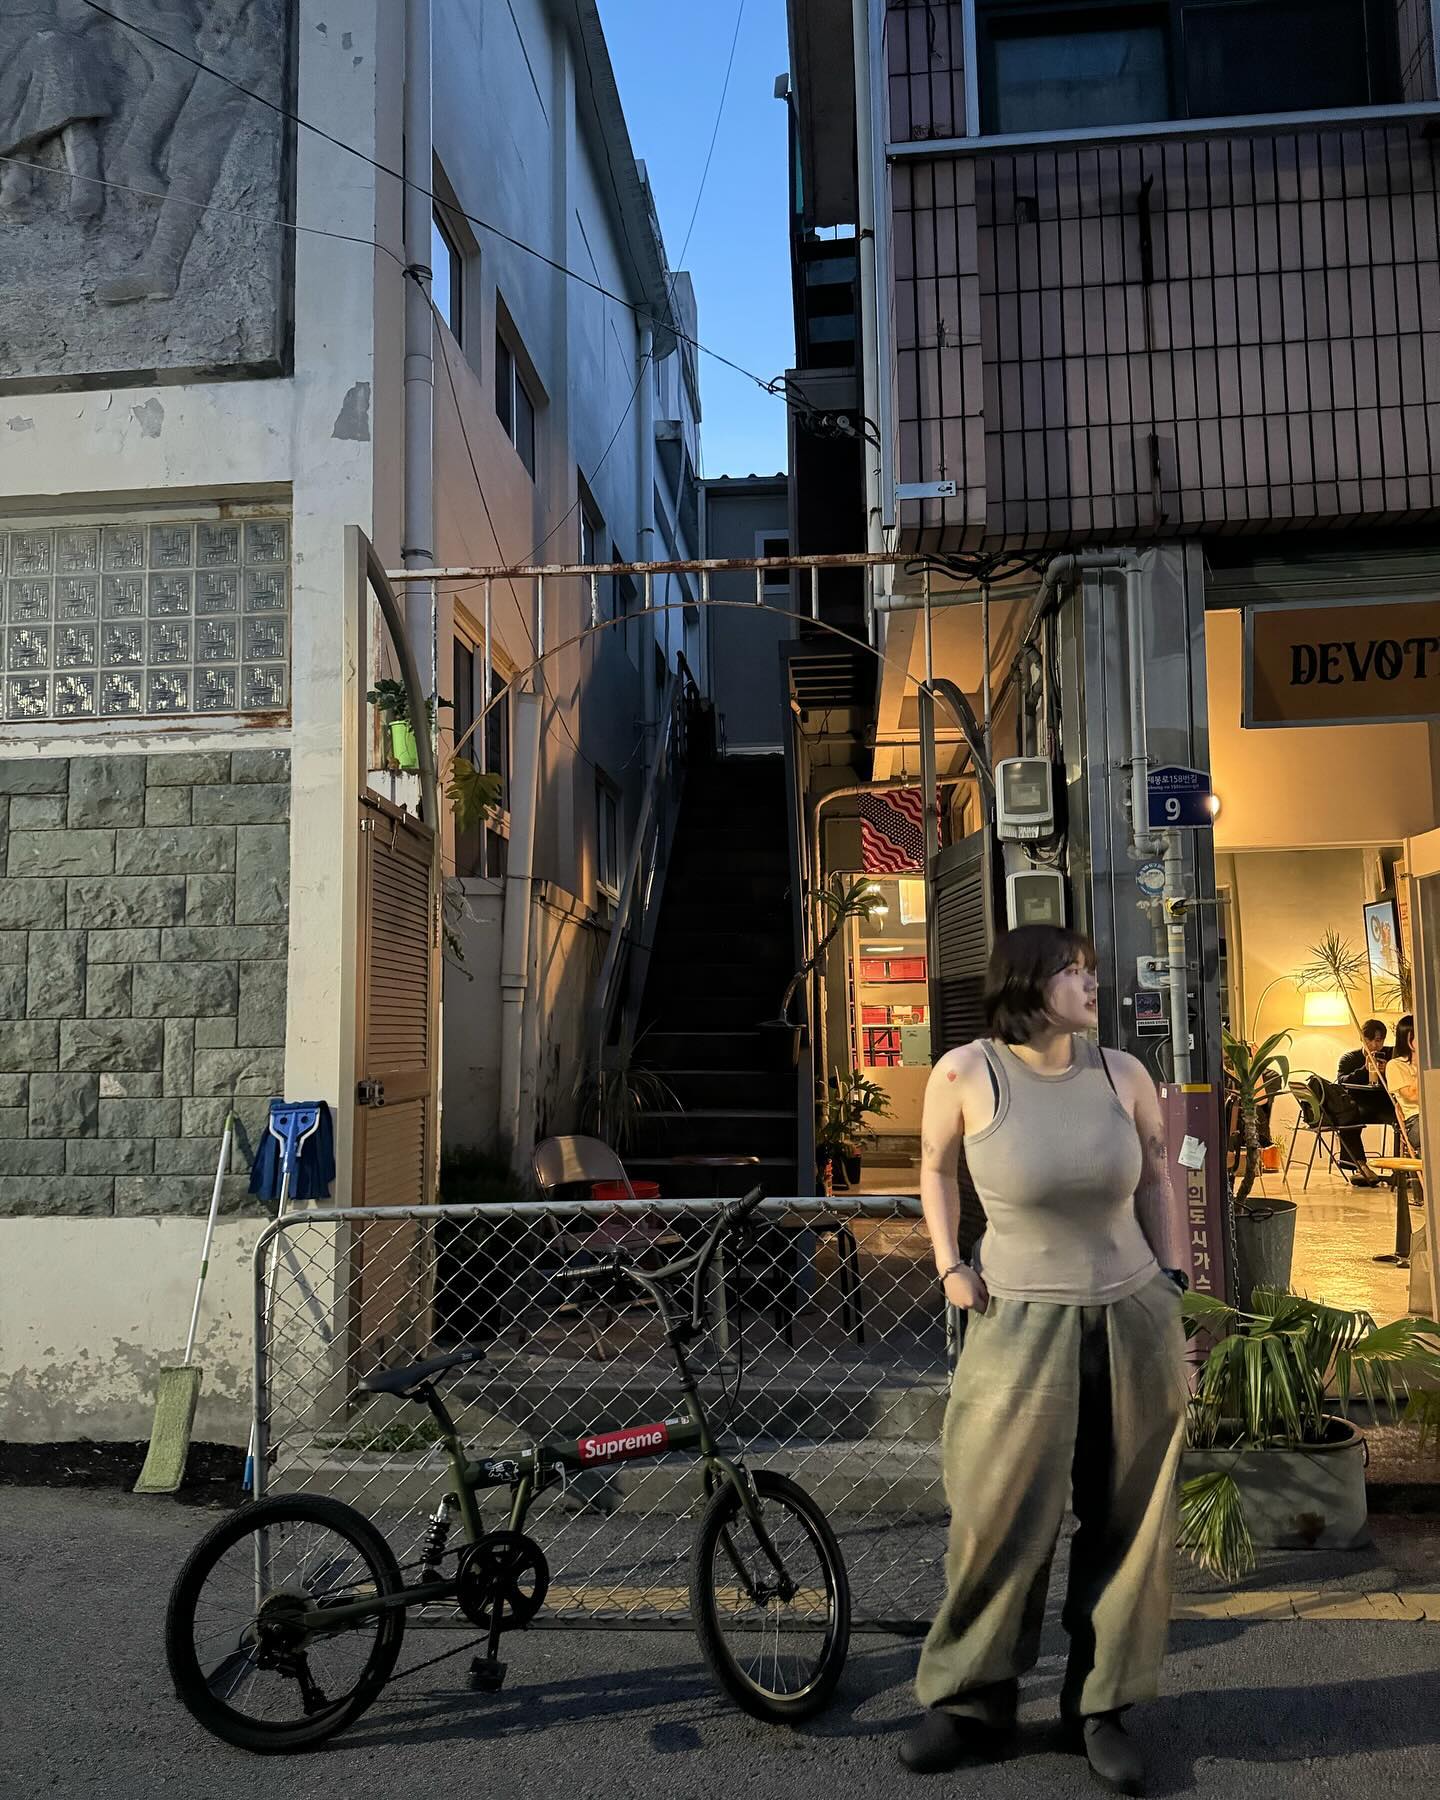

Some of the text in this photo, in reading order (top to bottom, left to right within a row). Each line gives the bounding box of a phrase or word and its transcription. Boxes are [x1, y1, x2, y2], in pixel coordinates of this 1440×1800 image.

[1289, 636, 1440, 685] DEVOT
[1165, 797, 1181, 821] 9
[584, 1431, 663, 1459] Supreme
